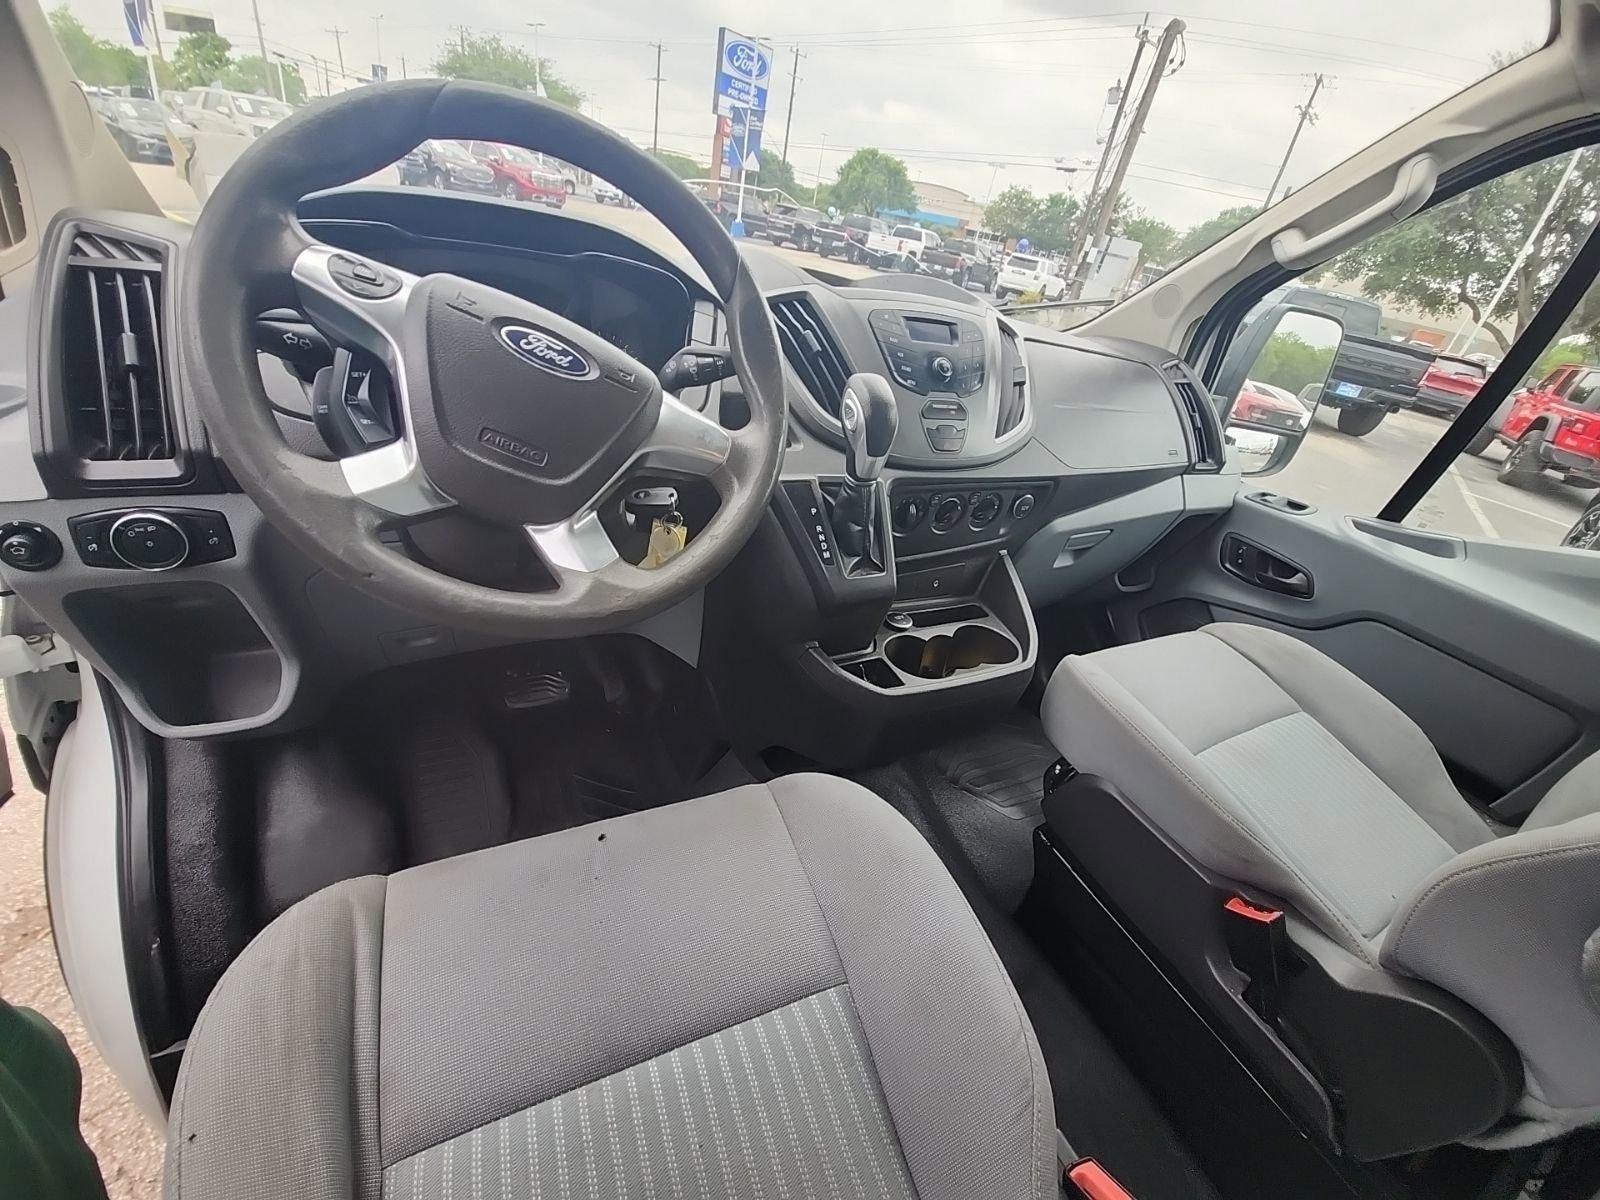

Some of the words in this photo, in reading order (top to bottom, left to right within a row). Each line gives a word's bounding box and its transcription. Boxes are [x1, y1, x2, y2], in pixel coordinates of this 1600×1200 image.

[731, 79, 758, 96] CERTIFID
[519, 334, 574, 368] Ford
[482, 432, 541, 461] AIRBAG
[810, 507, 817, 516] P
[815, 525, 823, 533] R
[818, 533, 825, 542] N
[820, 542, 828, 550] D
